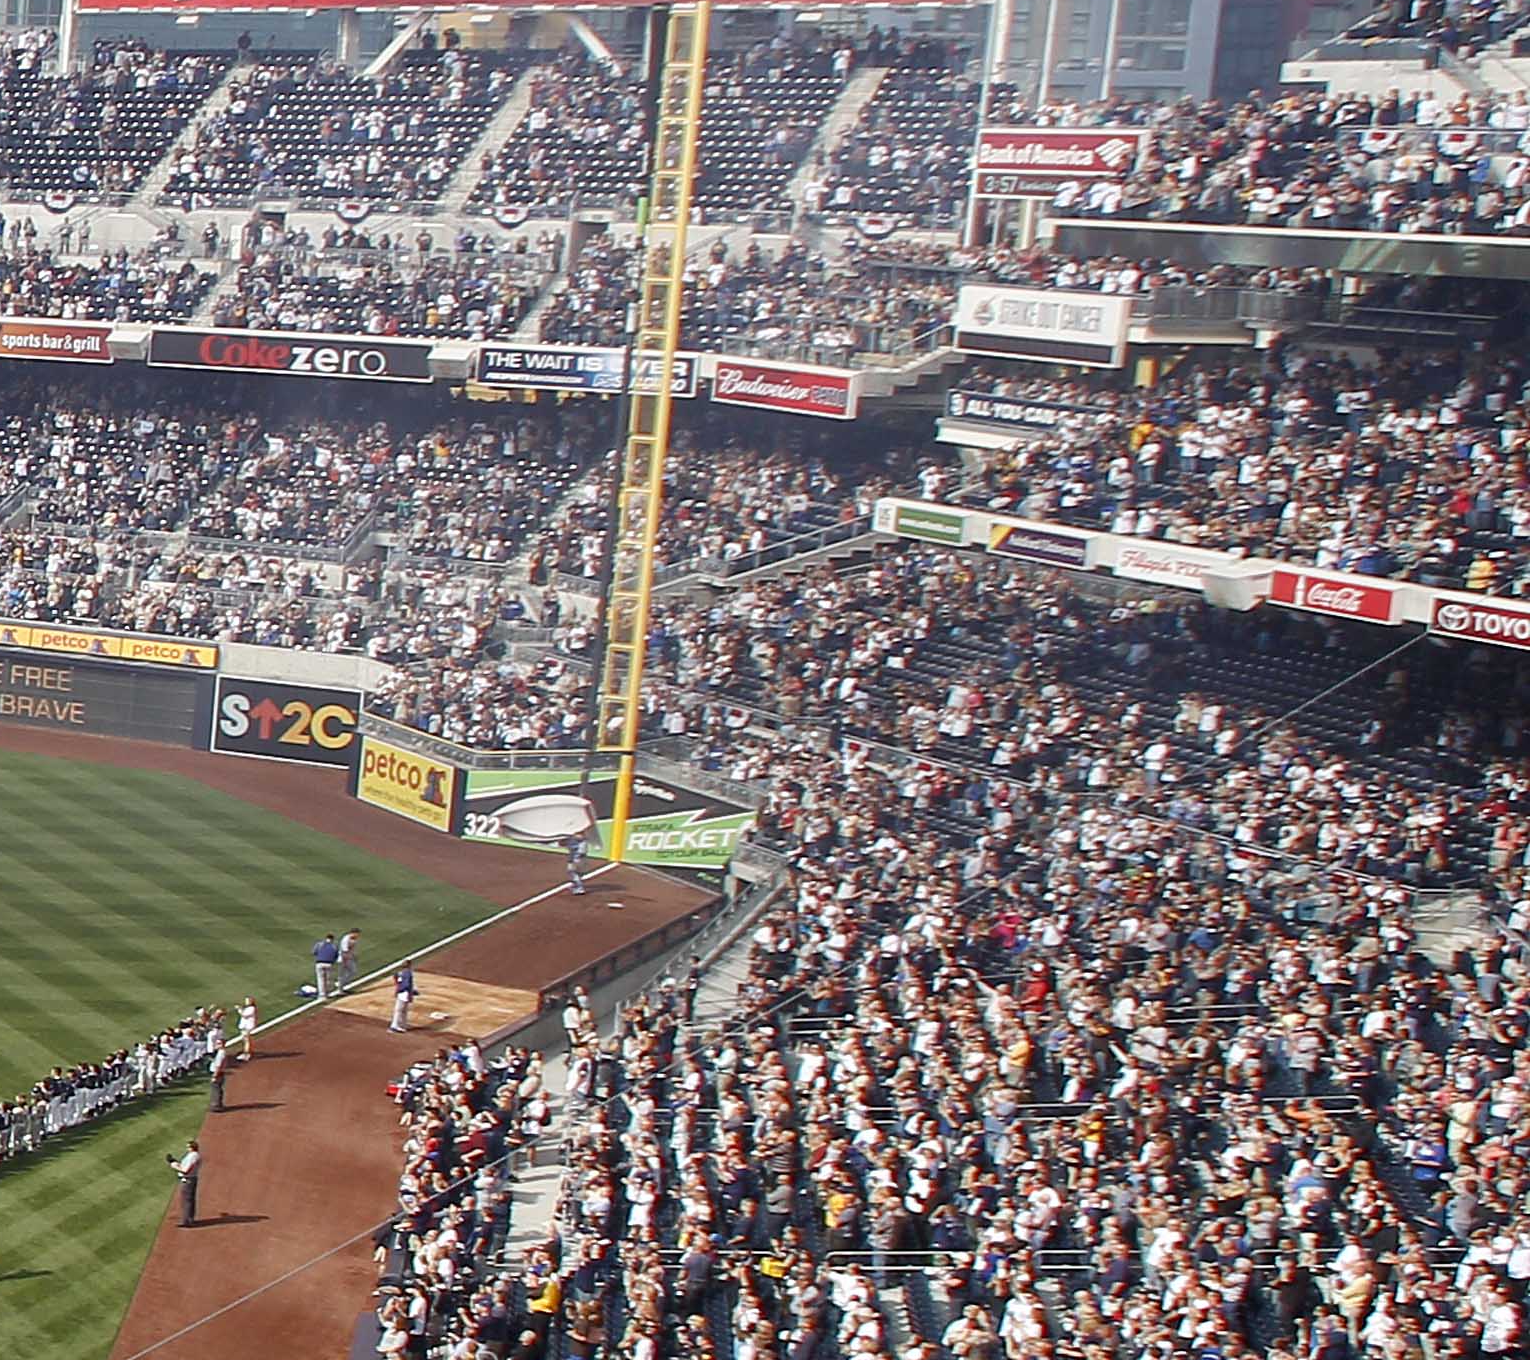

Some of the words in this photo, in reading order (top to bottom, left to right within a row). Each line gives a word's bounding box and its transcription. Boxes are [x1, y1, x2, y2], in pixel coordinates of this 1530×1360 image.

[2, 334, 41, 349] sports
[199, 335, 289, 369] Coke
[291, 347, 386, 375] zero
[485, 352, 522, 368] THE
[525, 353, 574, 370] WAIT
[577, 357, 602, 371] IS
[718, 368, 810, 399] Budweiser
[41, 631, 88, 649] petco
[132, 642, 180, 660] petco
[10, 664, 72, 691] FREE
[364, 747, 421, 790] petco
[464, 813, 500, 838] 322
[627, 829, 738, 851] ROCKET
